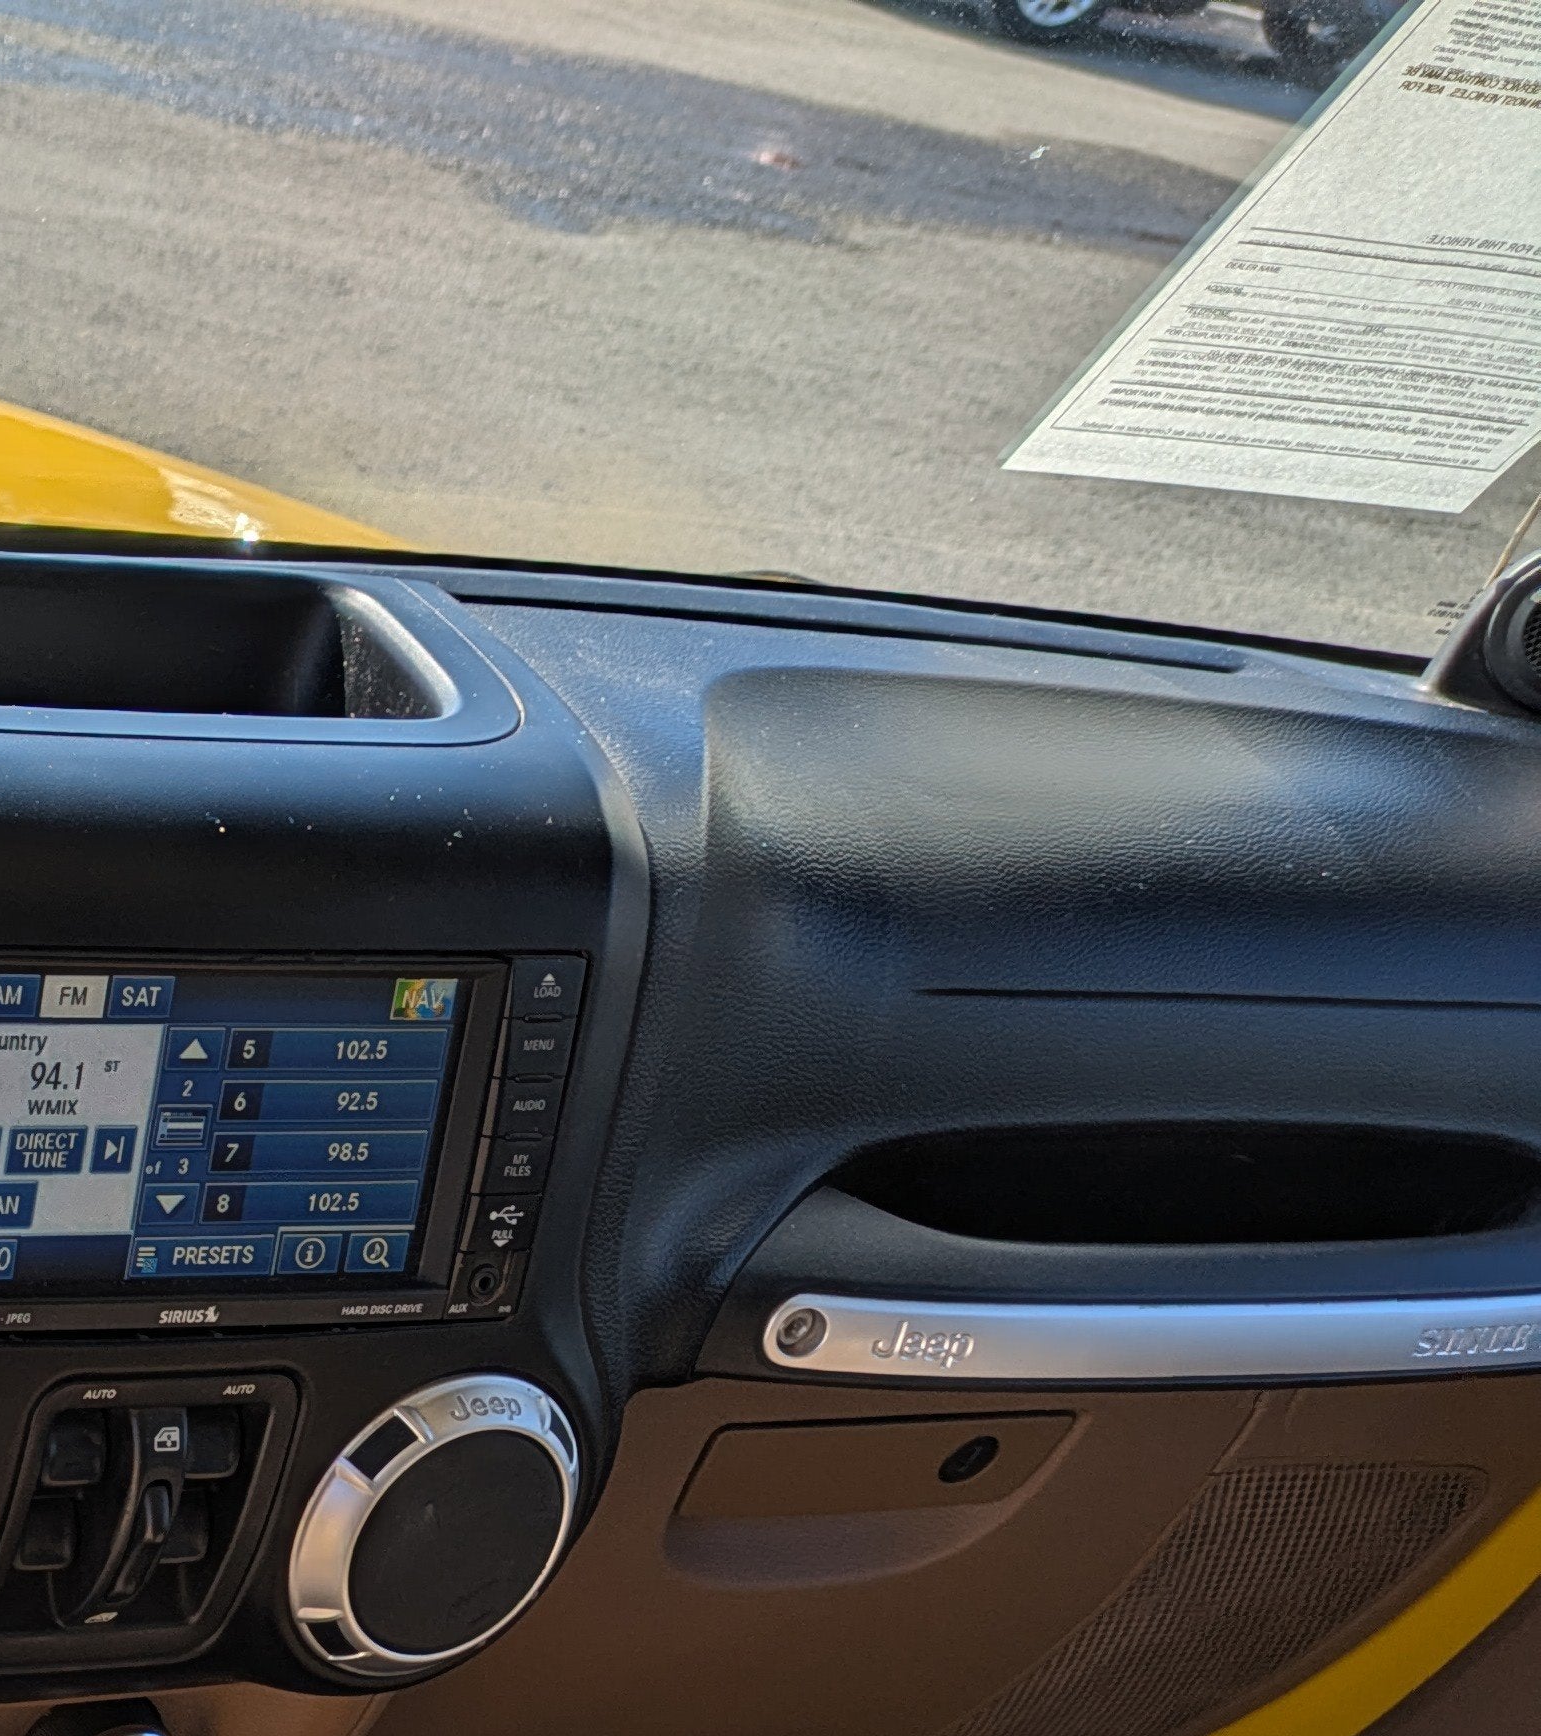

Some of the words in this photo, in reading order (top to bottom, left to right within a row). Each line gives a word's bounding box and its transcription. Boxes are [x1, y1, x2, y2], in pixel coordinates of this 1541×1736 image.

[58, 986, 88, 1006] FM
[121, 986, 162, 1007] SAT
[400, 987, 446, 1010] NAV
[533, 985, 562, 999] LOAD
[242, 1039, 256, 1060] 5
[335, 1039, 388, 1061] 102.5
[522, 1038, 555, 1052] MENU
[30, 1060, 84, 1091] 94.1
[103, 1060, 121, 1073] ST
[182, 1079, 193, 1097] 2
[27, 1099, 78, 1116] WMIX
[233, 1092, 247, 1112] 6
[336, 1091, 379, 1112] 92.5
[512, 1099, 546, 1112] AUDIO
[15, 1132, 79, 1151] DIRECT
[21, 1151, 68, 1170] TUNE
[226, 1143, 240, 1163] 7
[326, 1142, 370, 1162] 98.5
[144, 1160, 161, 1175] of
[177, 1158, 190, 1175] 3
[503, 1164, 532, 1178] FILES
[216, 1194, 231, 1214] 8
[307, 1192, 361, 1213] 102.5
[172, 1244, 255, 1266] PRESETS
[5, 1312, 32, 1325] JPEG
[158, 1308, 205, 1325] SIRIUS
[341, 1304, 369, 1317] HARD
[370, 1303, 393, 1315] DISC
[394, 1302, 423, 1315] DRIVE
[872, 1318, 976, 1370] Jeep
[83, 1388, 117, 1401] AUTO
[222, 1383, 256, 1396] AUTO
[448, 1391, 524, 1424] Jeep
